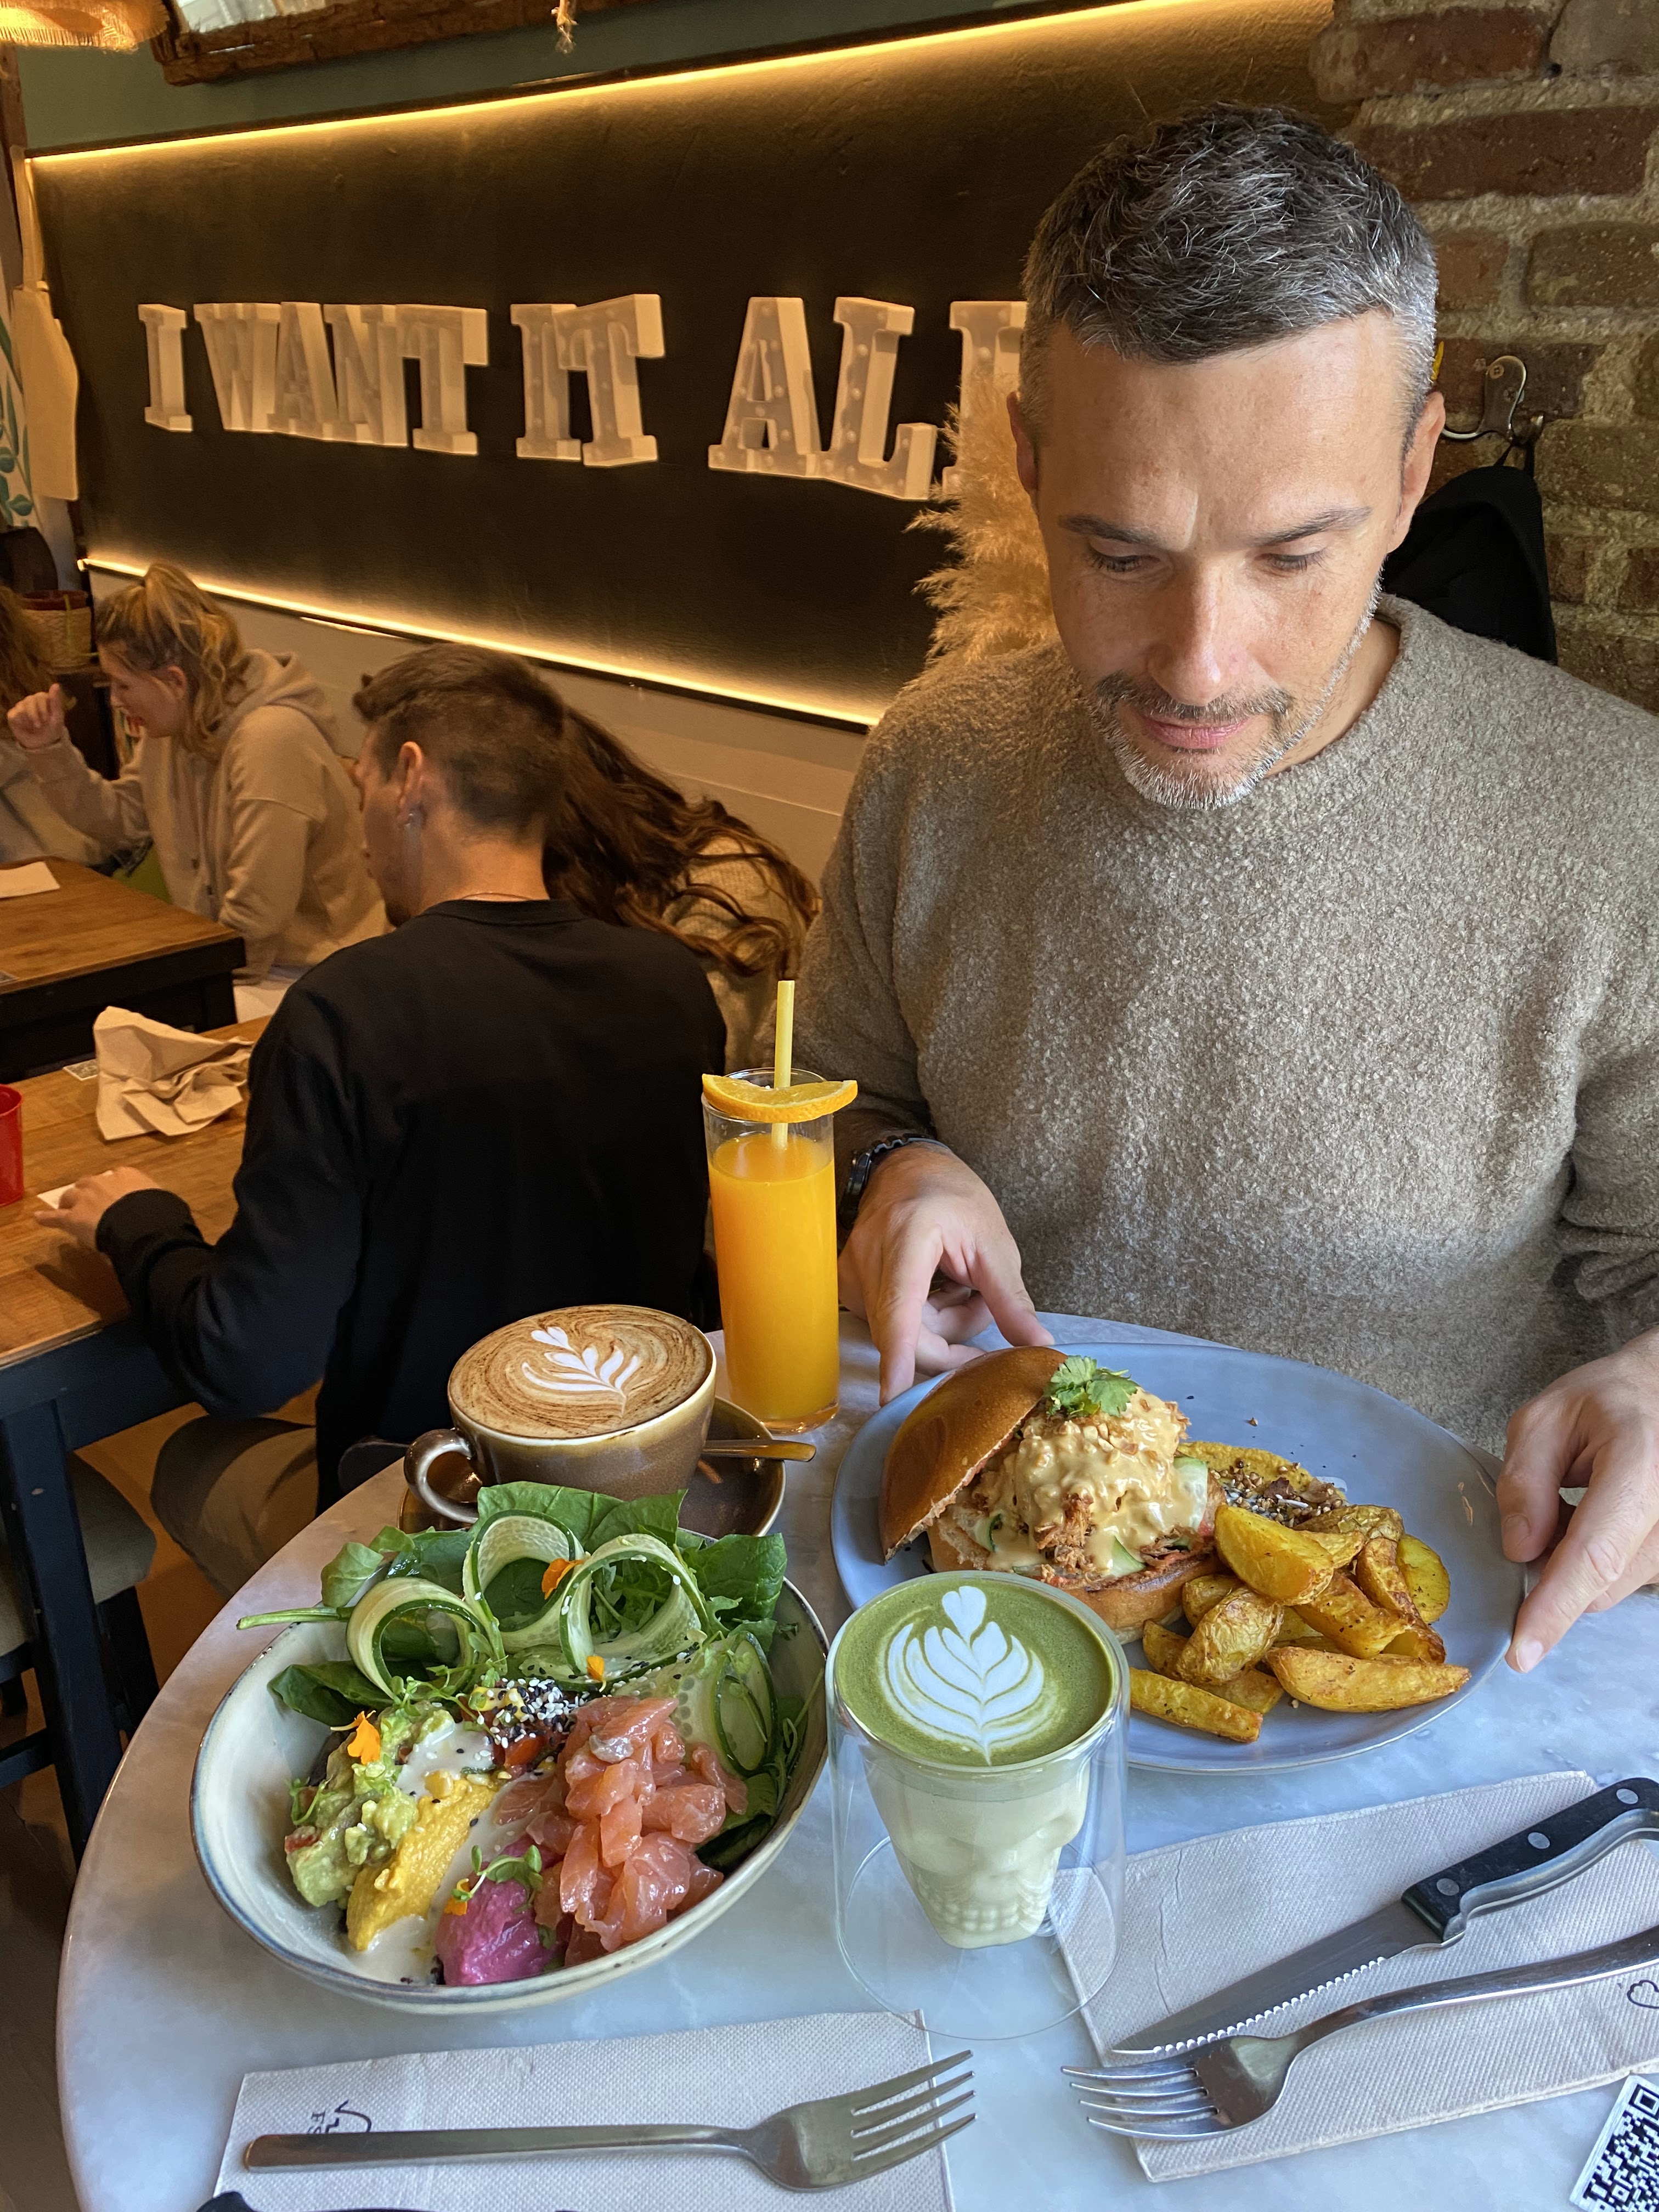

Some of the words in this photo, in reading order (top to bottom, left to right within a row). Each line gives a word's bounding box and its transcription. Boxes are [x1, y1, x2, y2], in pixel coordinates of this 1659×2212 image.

[138, 304, 193, 432] I
[193, 302, 489, 455] WANT
[510, 294, 665, 467] IT
